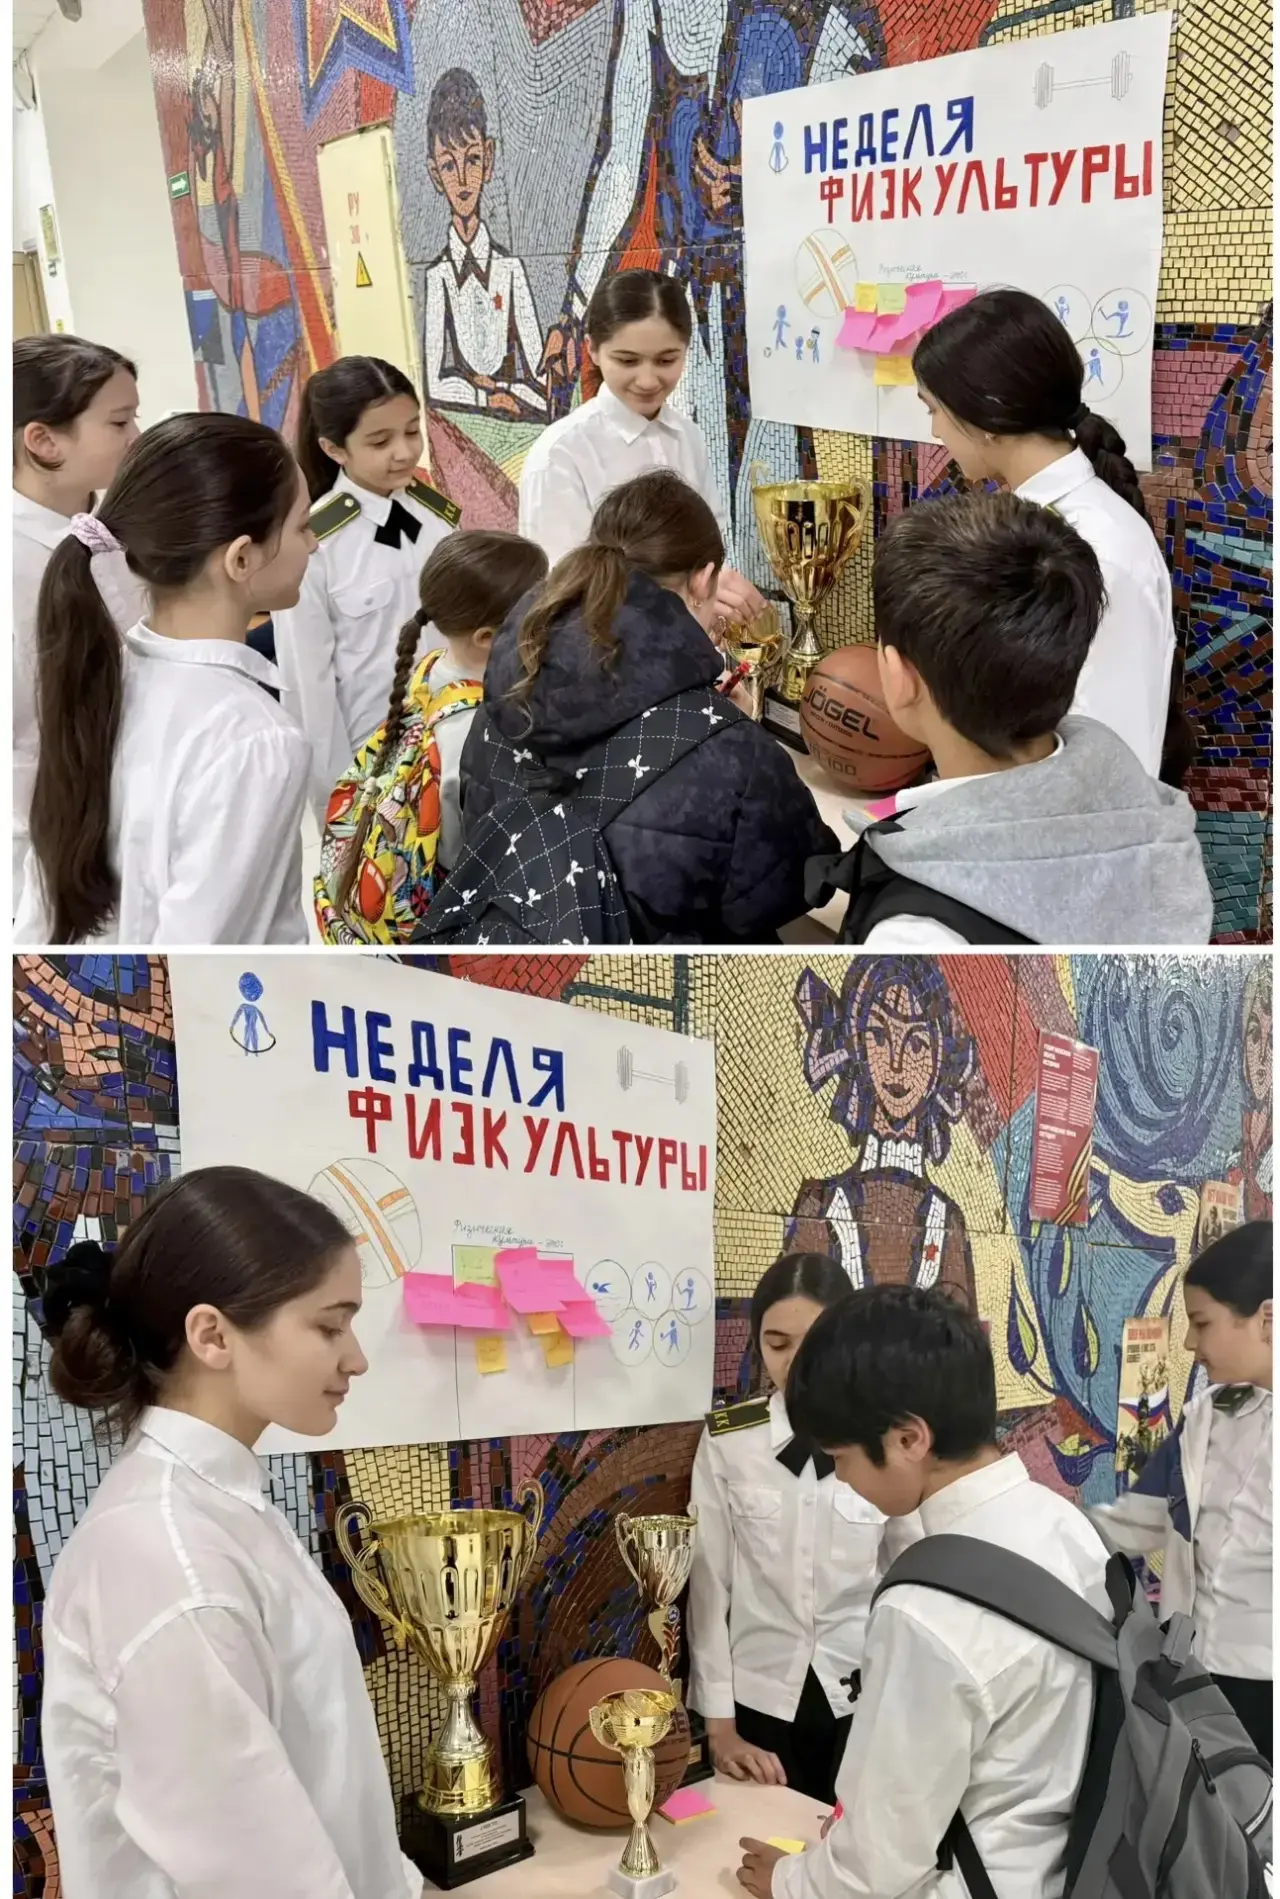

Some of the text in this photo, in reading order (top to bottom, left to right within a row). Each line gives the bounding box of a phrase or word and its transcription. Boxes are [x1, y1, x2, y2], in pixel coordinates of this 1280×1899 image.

[804, 95, 974, 174] НЕДЕЛЯ
[820, 140, 1153, 224] ФИЗКУЛЬТУРЫ
[803, 685, 880, 742] JÖGEL
[311, 1000, 565, 1112] НЕДЕЛЯ
[348, 1086, 708, 1192] ФИЗКУЛЬТУРЫ
